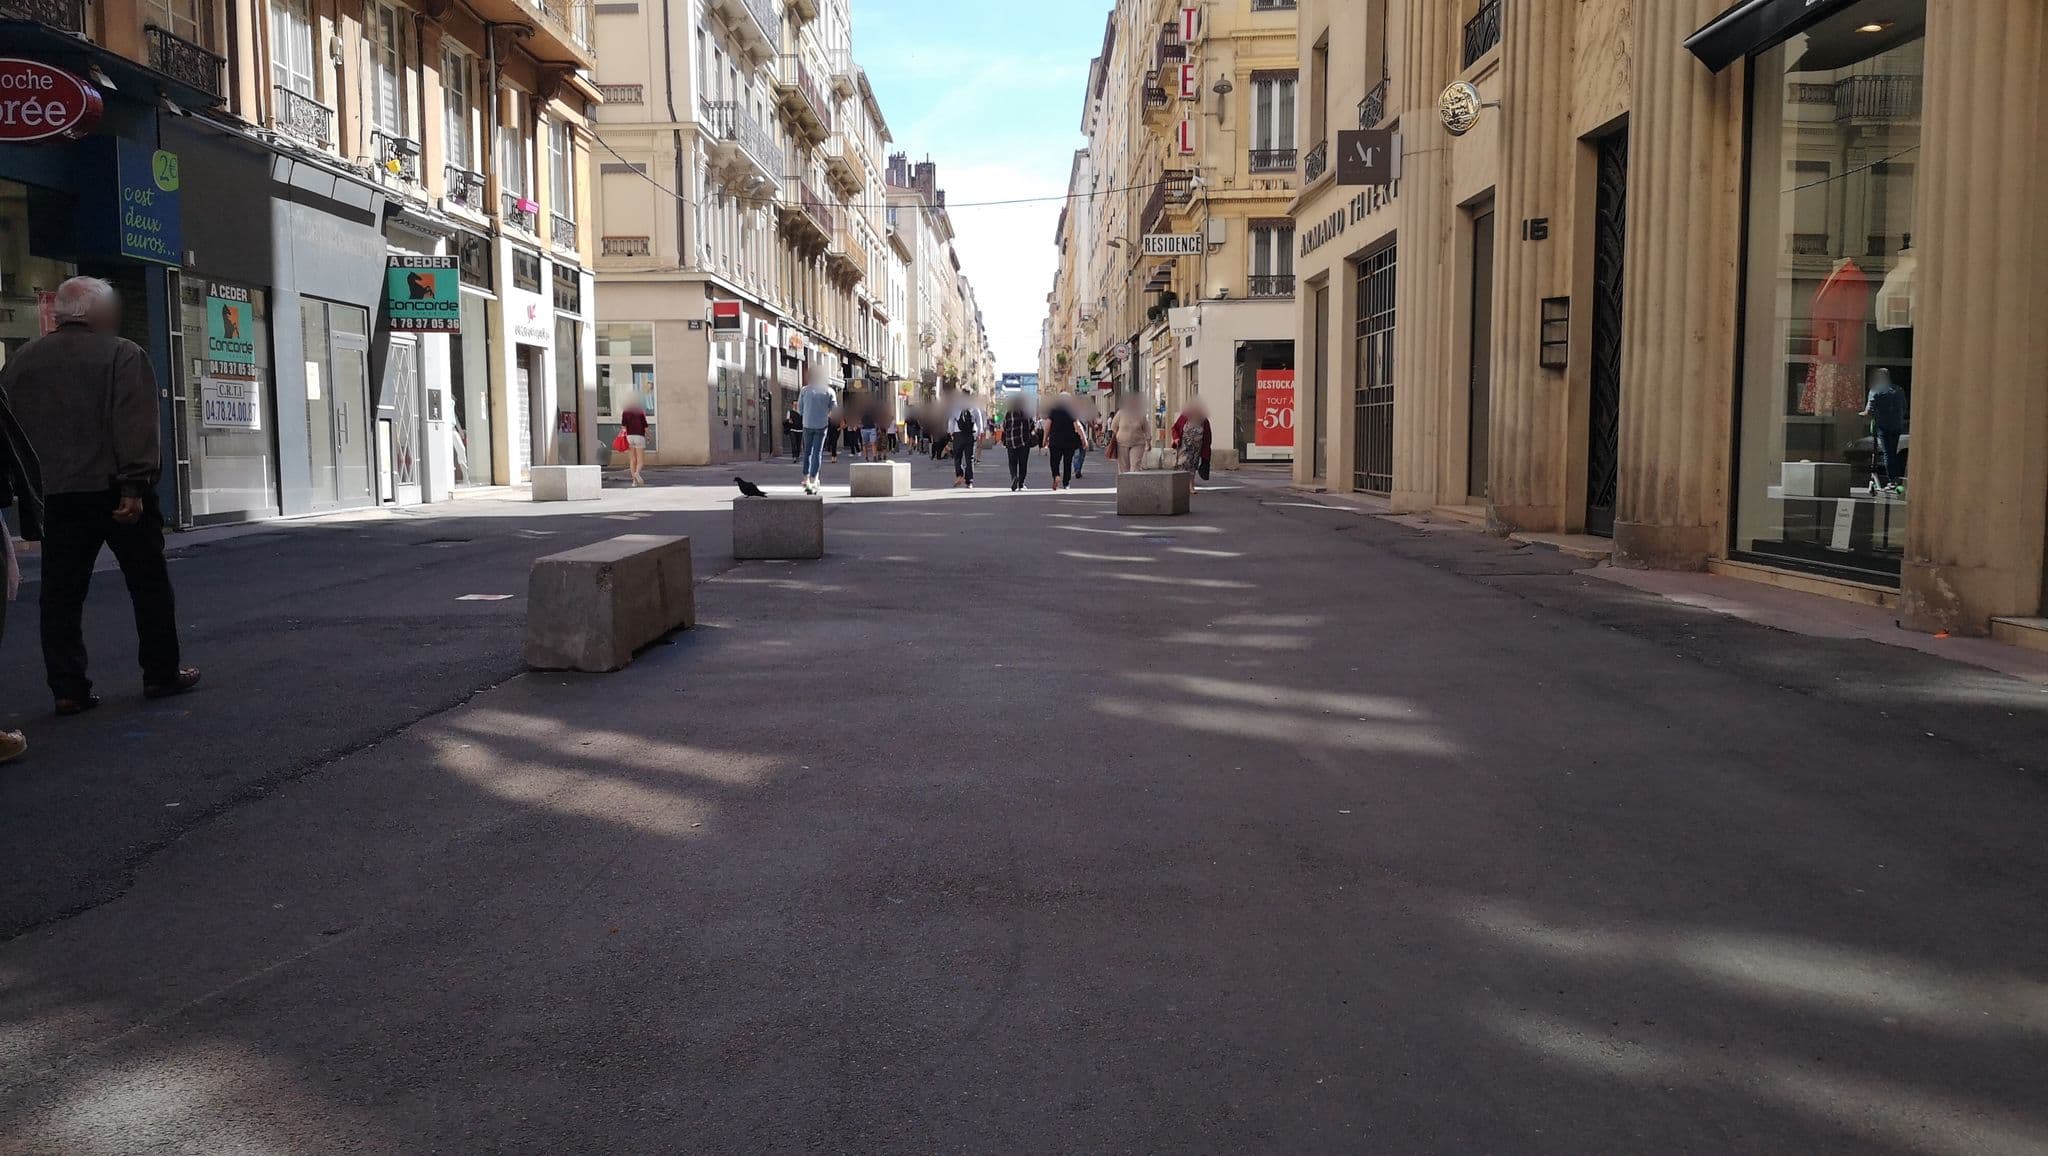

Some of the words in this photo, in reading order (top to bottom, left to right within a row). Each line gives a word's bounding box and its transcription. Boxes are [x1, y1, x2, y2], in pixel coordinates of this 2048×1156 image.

[1, 69, 53, 90] oche
[125, 206, 162, 232] deux
[1300, 207, 1345, 258] ARMAND
[1522, 217, 1548, 241] 16
[1144, 236, 1201, 253] RESIDENCE
[389, 256, 400, 268] A
[403, 256, 451, 268] CEDER
[210, 283, 218, 297] A
[219, 285, 248, 302] CEDER
[400, 318, 413, 329] 78
[415, 318, 428, 329] 37
[431, 318, 444, 329] 05
[447, 318, 460, 329] 36
[208, 336, 254, 354] Concorde
[220, 361, 228, 374] 78
[229, 362, 237, 375] 37
[238, 363, 246, 376] 05
[1265, 397, 1287, 405] TOUT
[1257, 407, 1295, 430] -50
